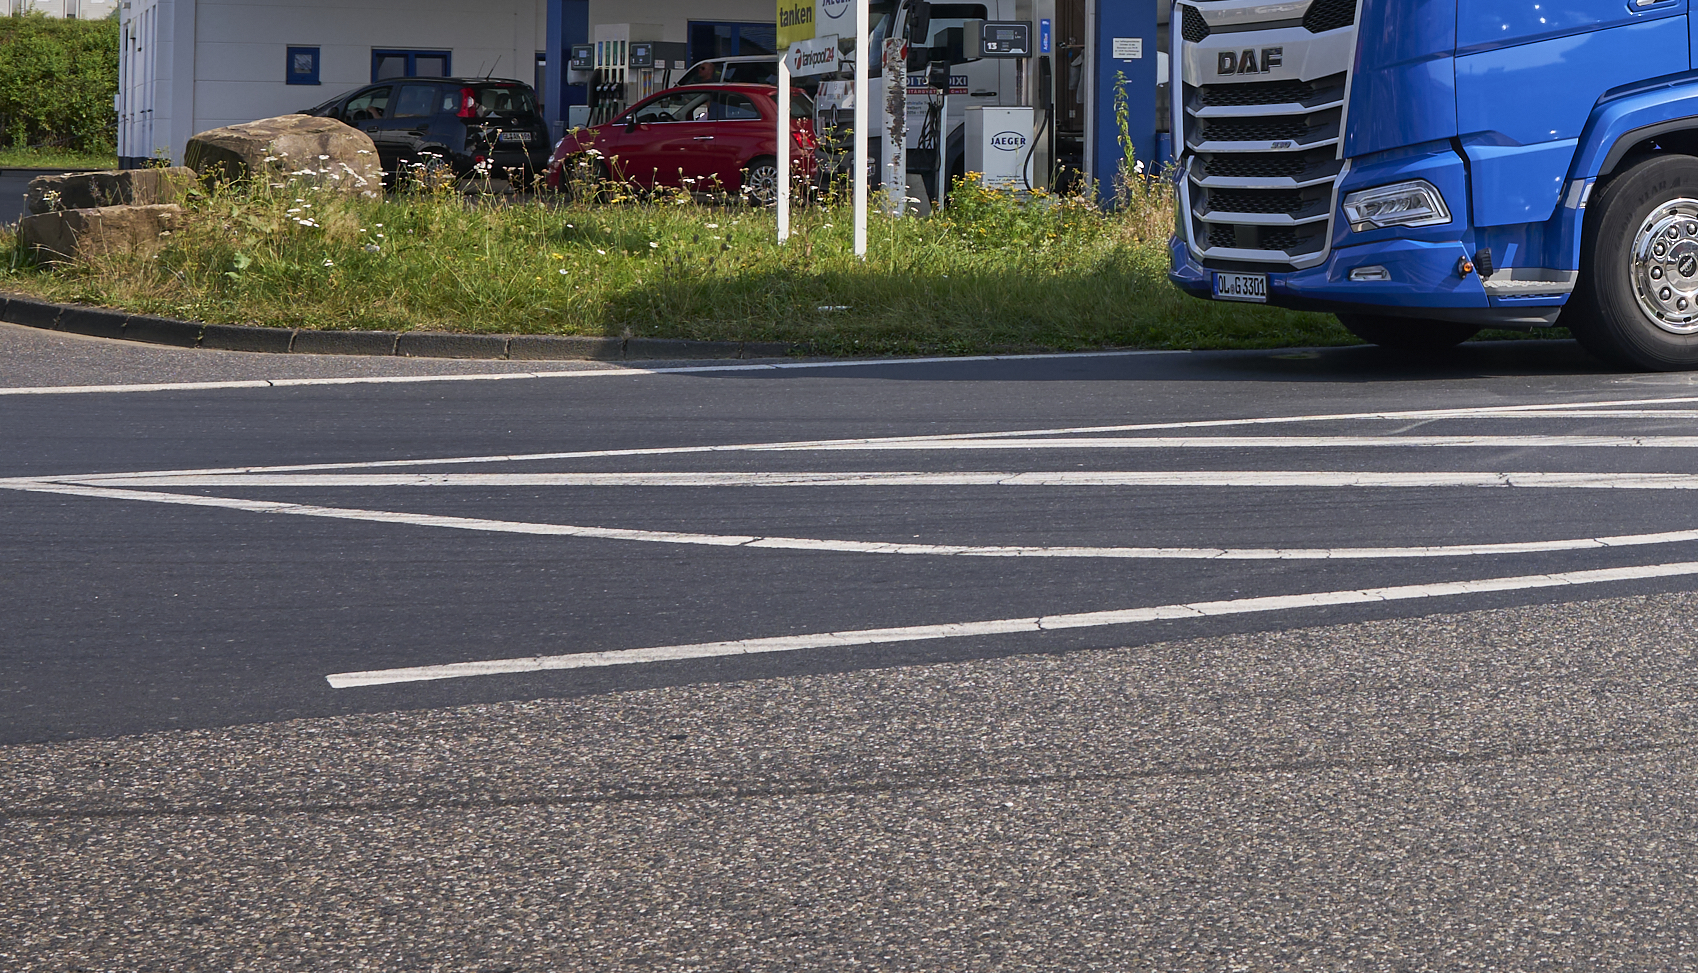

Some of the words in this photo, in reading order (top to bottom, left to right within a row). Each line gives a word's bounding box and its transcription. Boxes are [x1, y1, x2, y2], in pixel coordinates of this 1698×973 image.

[779, 3, 812, 28] tanken
[987, 42, 998, 50] 13
[802, 46, 835, 69] tankpool24
[1217, 46, 1283, 76] DAF
[991, 137, 1026, 145] JAEGER
[1219, 274, 1230, 294] OL
[1234, 276, 1241, 295] G
[1242, 277, 1266, 296] 3301
